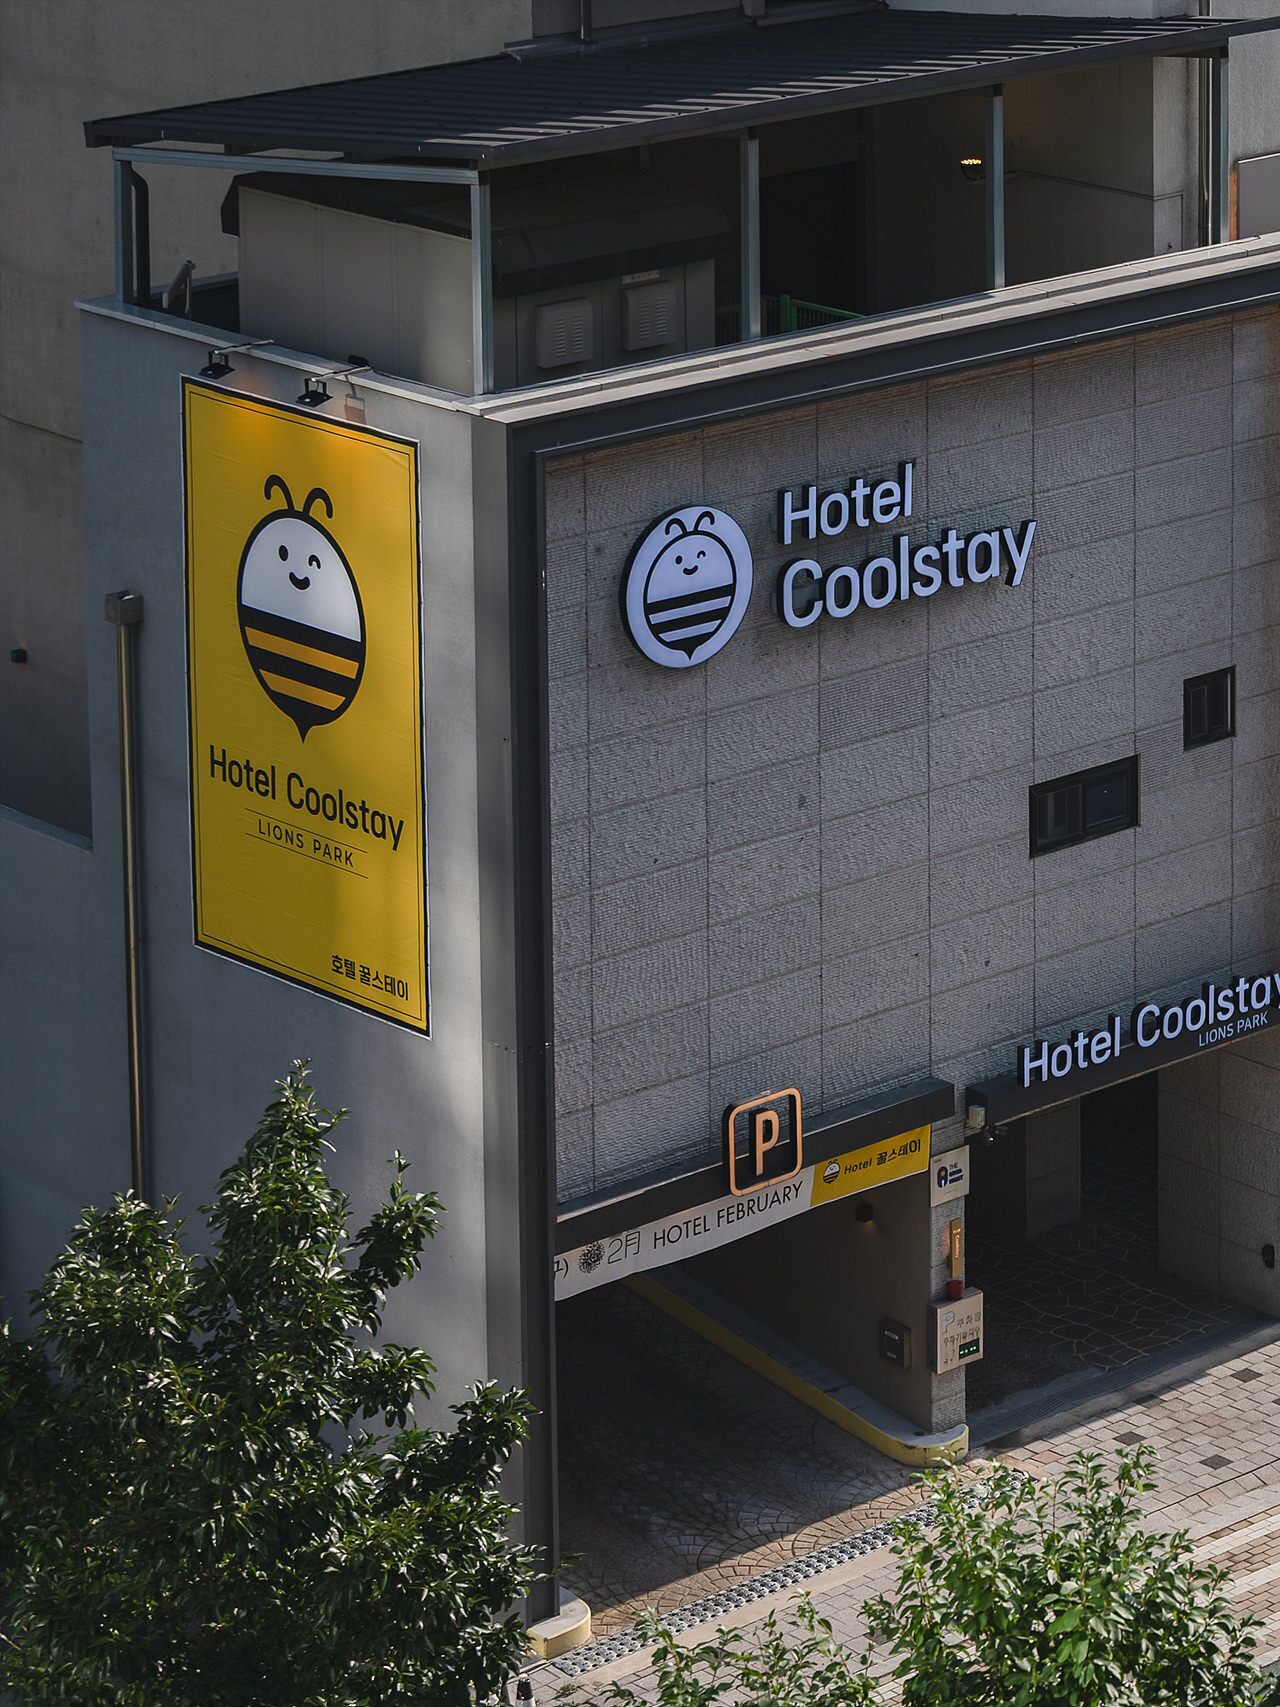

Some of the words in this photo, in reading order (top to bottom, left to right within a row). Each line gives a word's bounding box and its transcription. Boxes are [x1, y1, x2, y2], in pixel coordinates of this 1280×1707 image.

[782, 463, 913, 545] Hotel
[781, 521, 1037, 628] Coolstay
[209, 744, 276, 800] Hotel
[286, 772, 404, 852] Coolstay
[258, 818, 304, 849] LIONS
[313, 839, 354, 868] PARK
[331, 954, 356, 980] 호텔
[359, 965, 409, 1001] 꿀스테이
[1022, 1016, 1120, 1088] Hotel
[1198, 1024, 1234, 1048] LIONS
[1237, 1010, 1268, 1034] PARK
[754, 1110, 780, 1176] P
[607, 1230, 640, 1264] 2月
[652, 1214, 711, 1250] HOTEL
[716, 1180, 803, 1228] FEBRUARY
[844, 1157, 872, 1176] Hotel
[876, 1138, 922, 1166] 꿀스테이
